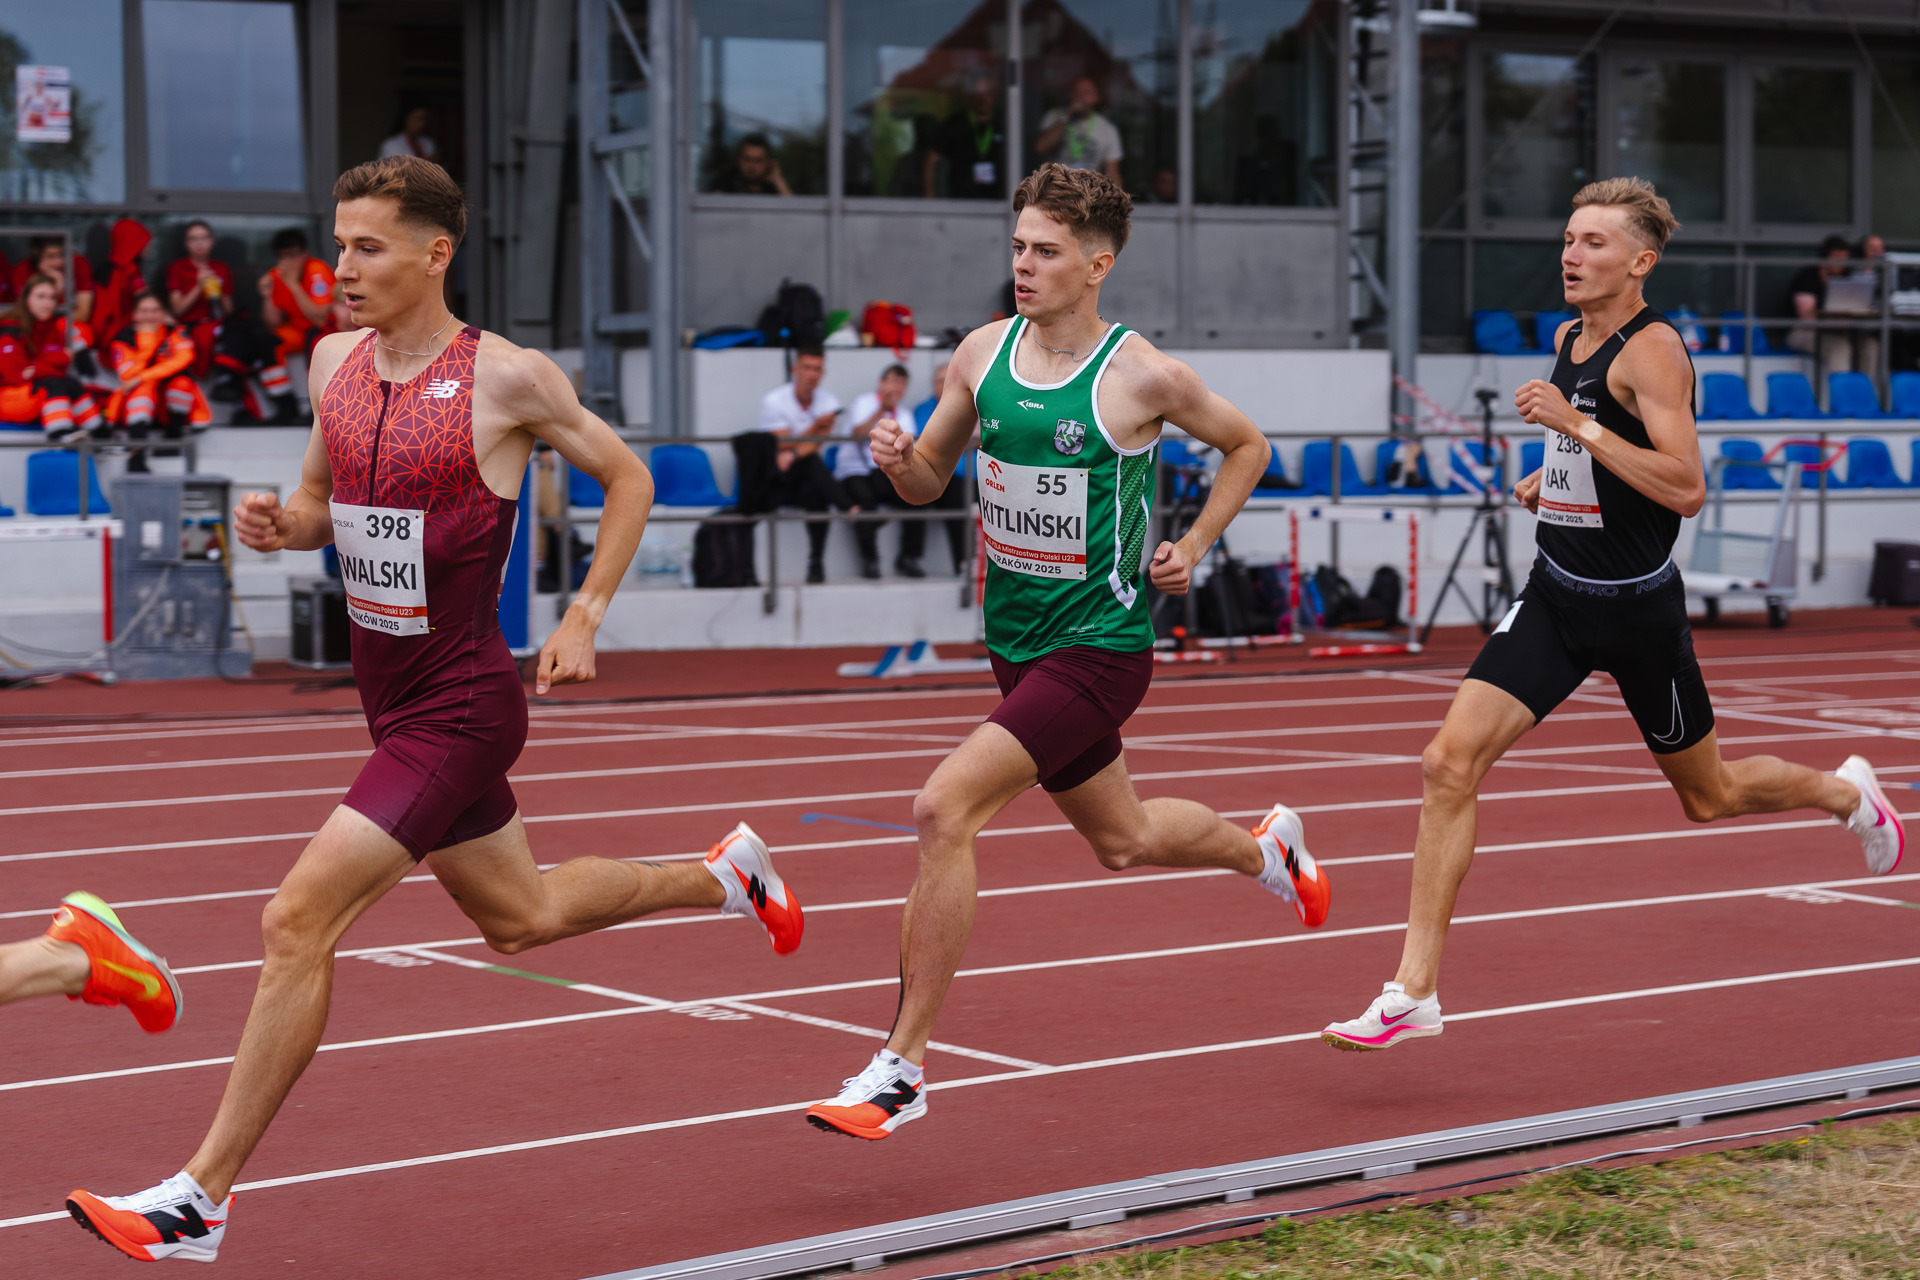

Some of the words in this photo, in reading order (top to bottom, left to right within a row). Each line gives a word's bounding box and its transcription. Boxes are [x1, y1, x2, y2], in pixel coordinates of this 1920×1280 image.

[985, 478, 1005, 493] ORLEN
[1036, 473, 1067, 496] 55
[982, 496, 1081, 540] KITLIŃSKI
[1565, 514, 1584, 524] 2025
[366, 514, 411, 540] 398
[1002, 546, 1039, 559] Mistrzostwa
[1040, 553, 1061, 561] Polski
[338, 551, 417, 591] WALSKI
[1035, 563, 1062, 575] 2025
[1576, 582, 1619, 597] PRO
[1636, 564, 1673, 595] NIKE
[380, 605, 398, 615] Polski
[399, 608, 414, 616] U23
[379, 618, 400, 631] 2025
